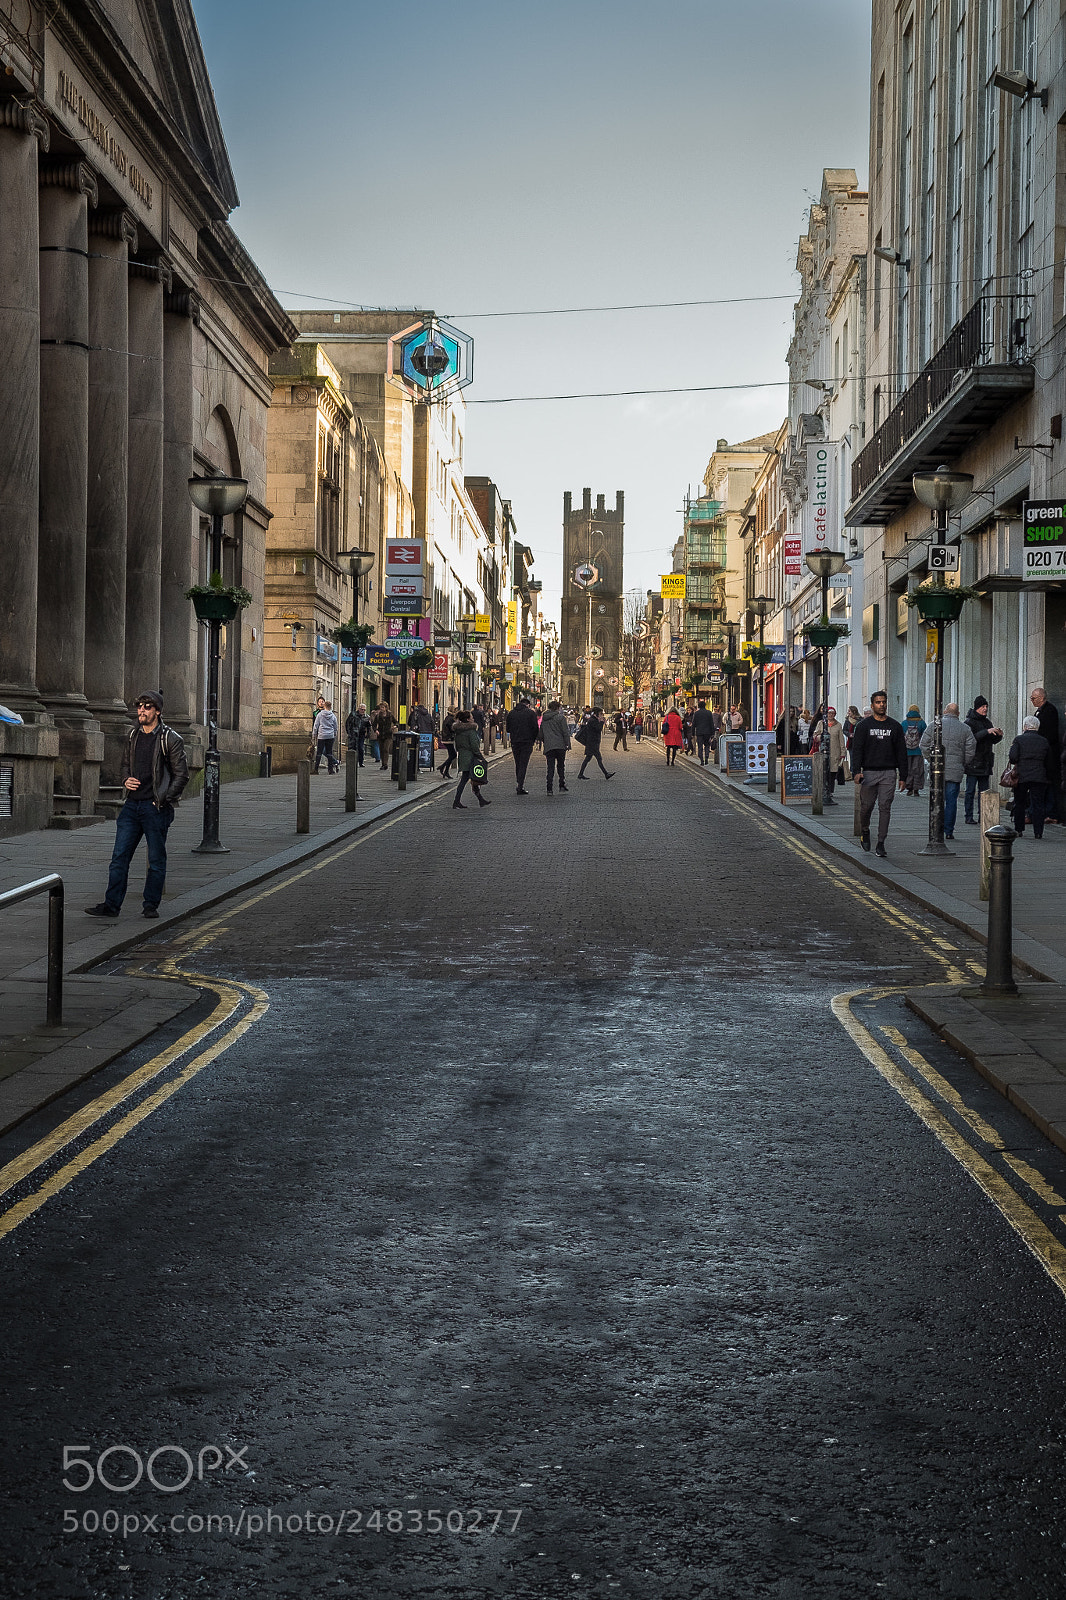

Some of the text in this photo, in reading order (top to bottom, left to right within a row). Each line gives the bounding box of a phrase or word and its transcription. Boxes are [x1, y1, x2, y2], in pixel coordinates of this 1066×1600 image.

[58, 70, 153, 211] THE LYCEUM POST OFFICE
[812, 449, 828, 542] cafelatino
[1026, 526, 1064, 542] SHOP
[1026, 551, 1052, 567] 020
[385, 640, 423, 648] CENTRAL
